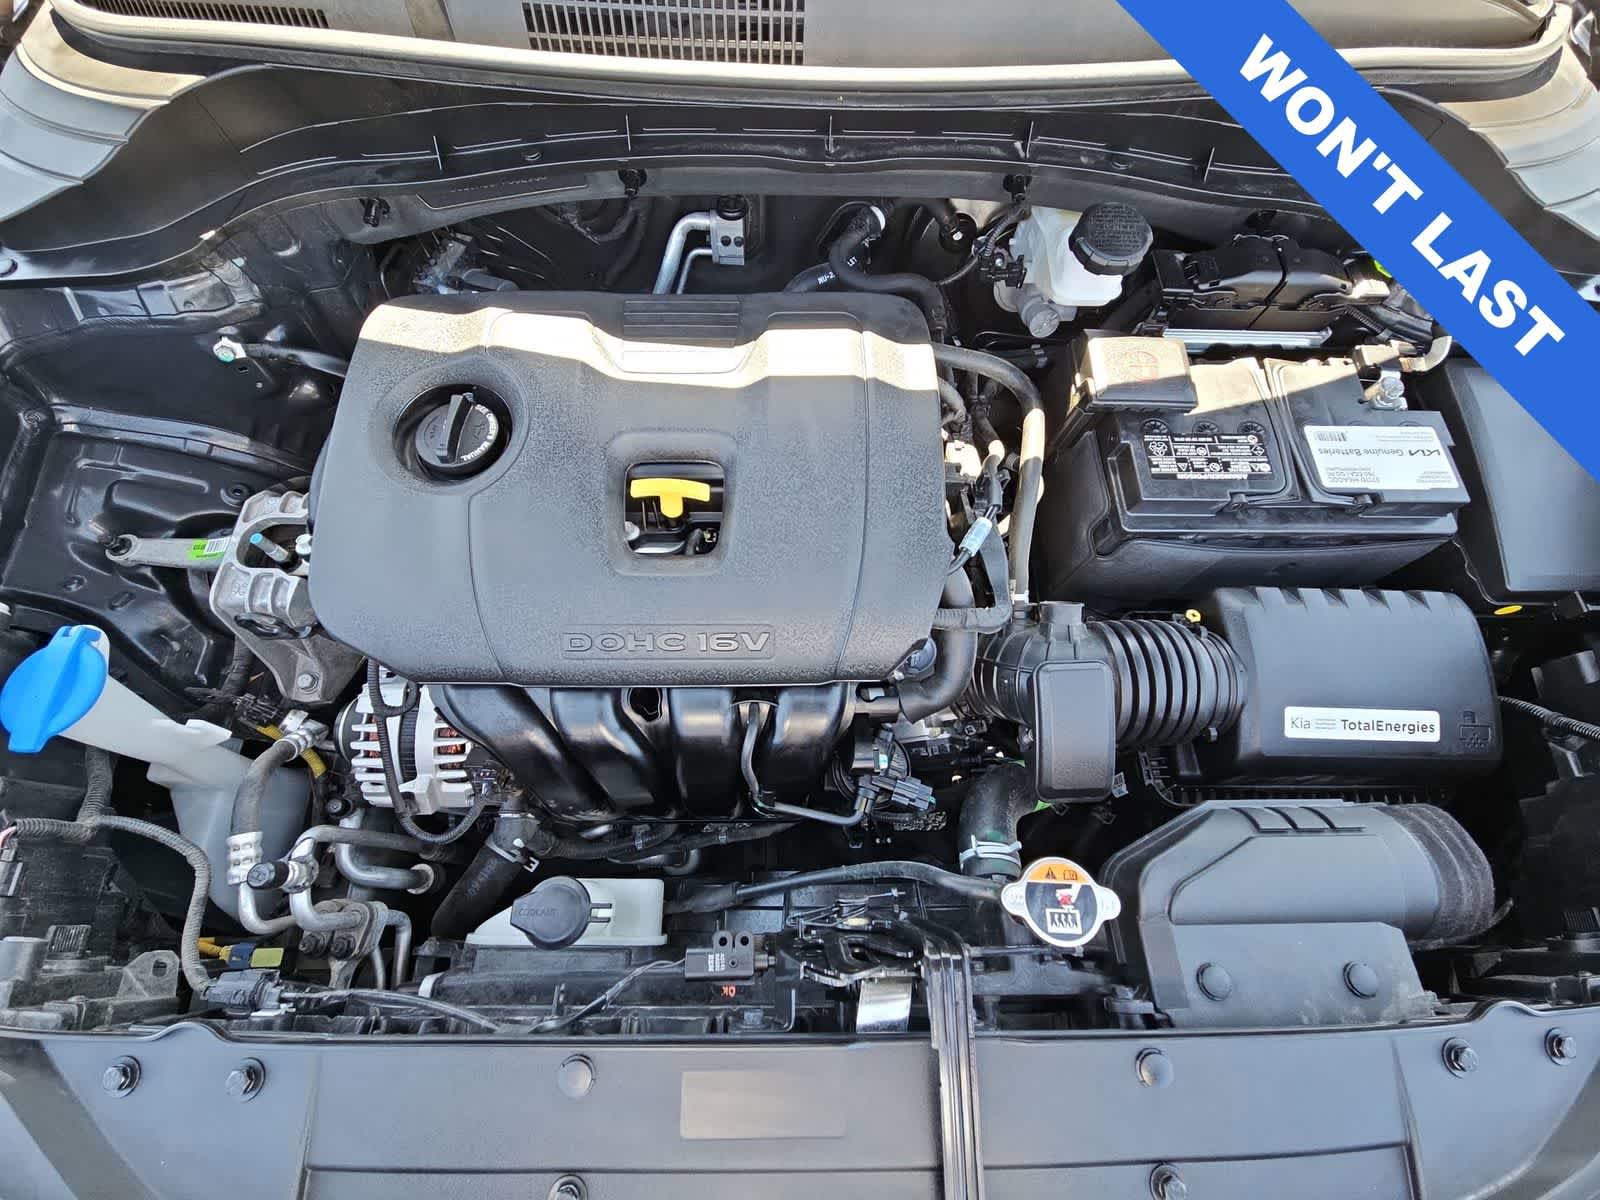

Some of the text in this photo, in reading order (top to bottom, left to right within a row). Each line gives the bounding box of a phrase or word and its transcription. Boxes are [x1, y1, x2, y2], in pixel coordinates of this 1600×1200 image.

[460, 440, 491, 461] MANUAL
[1317, 448, 1441, 457] KIA Genuine Batteries
[563, 631, 771, 652] DOHC 16V
[1290, 717, 1436, 735] Kia TotalEnergies
